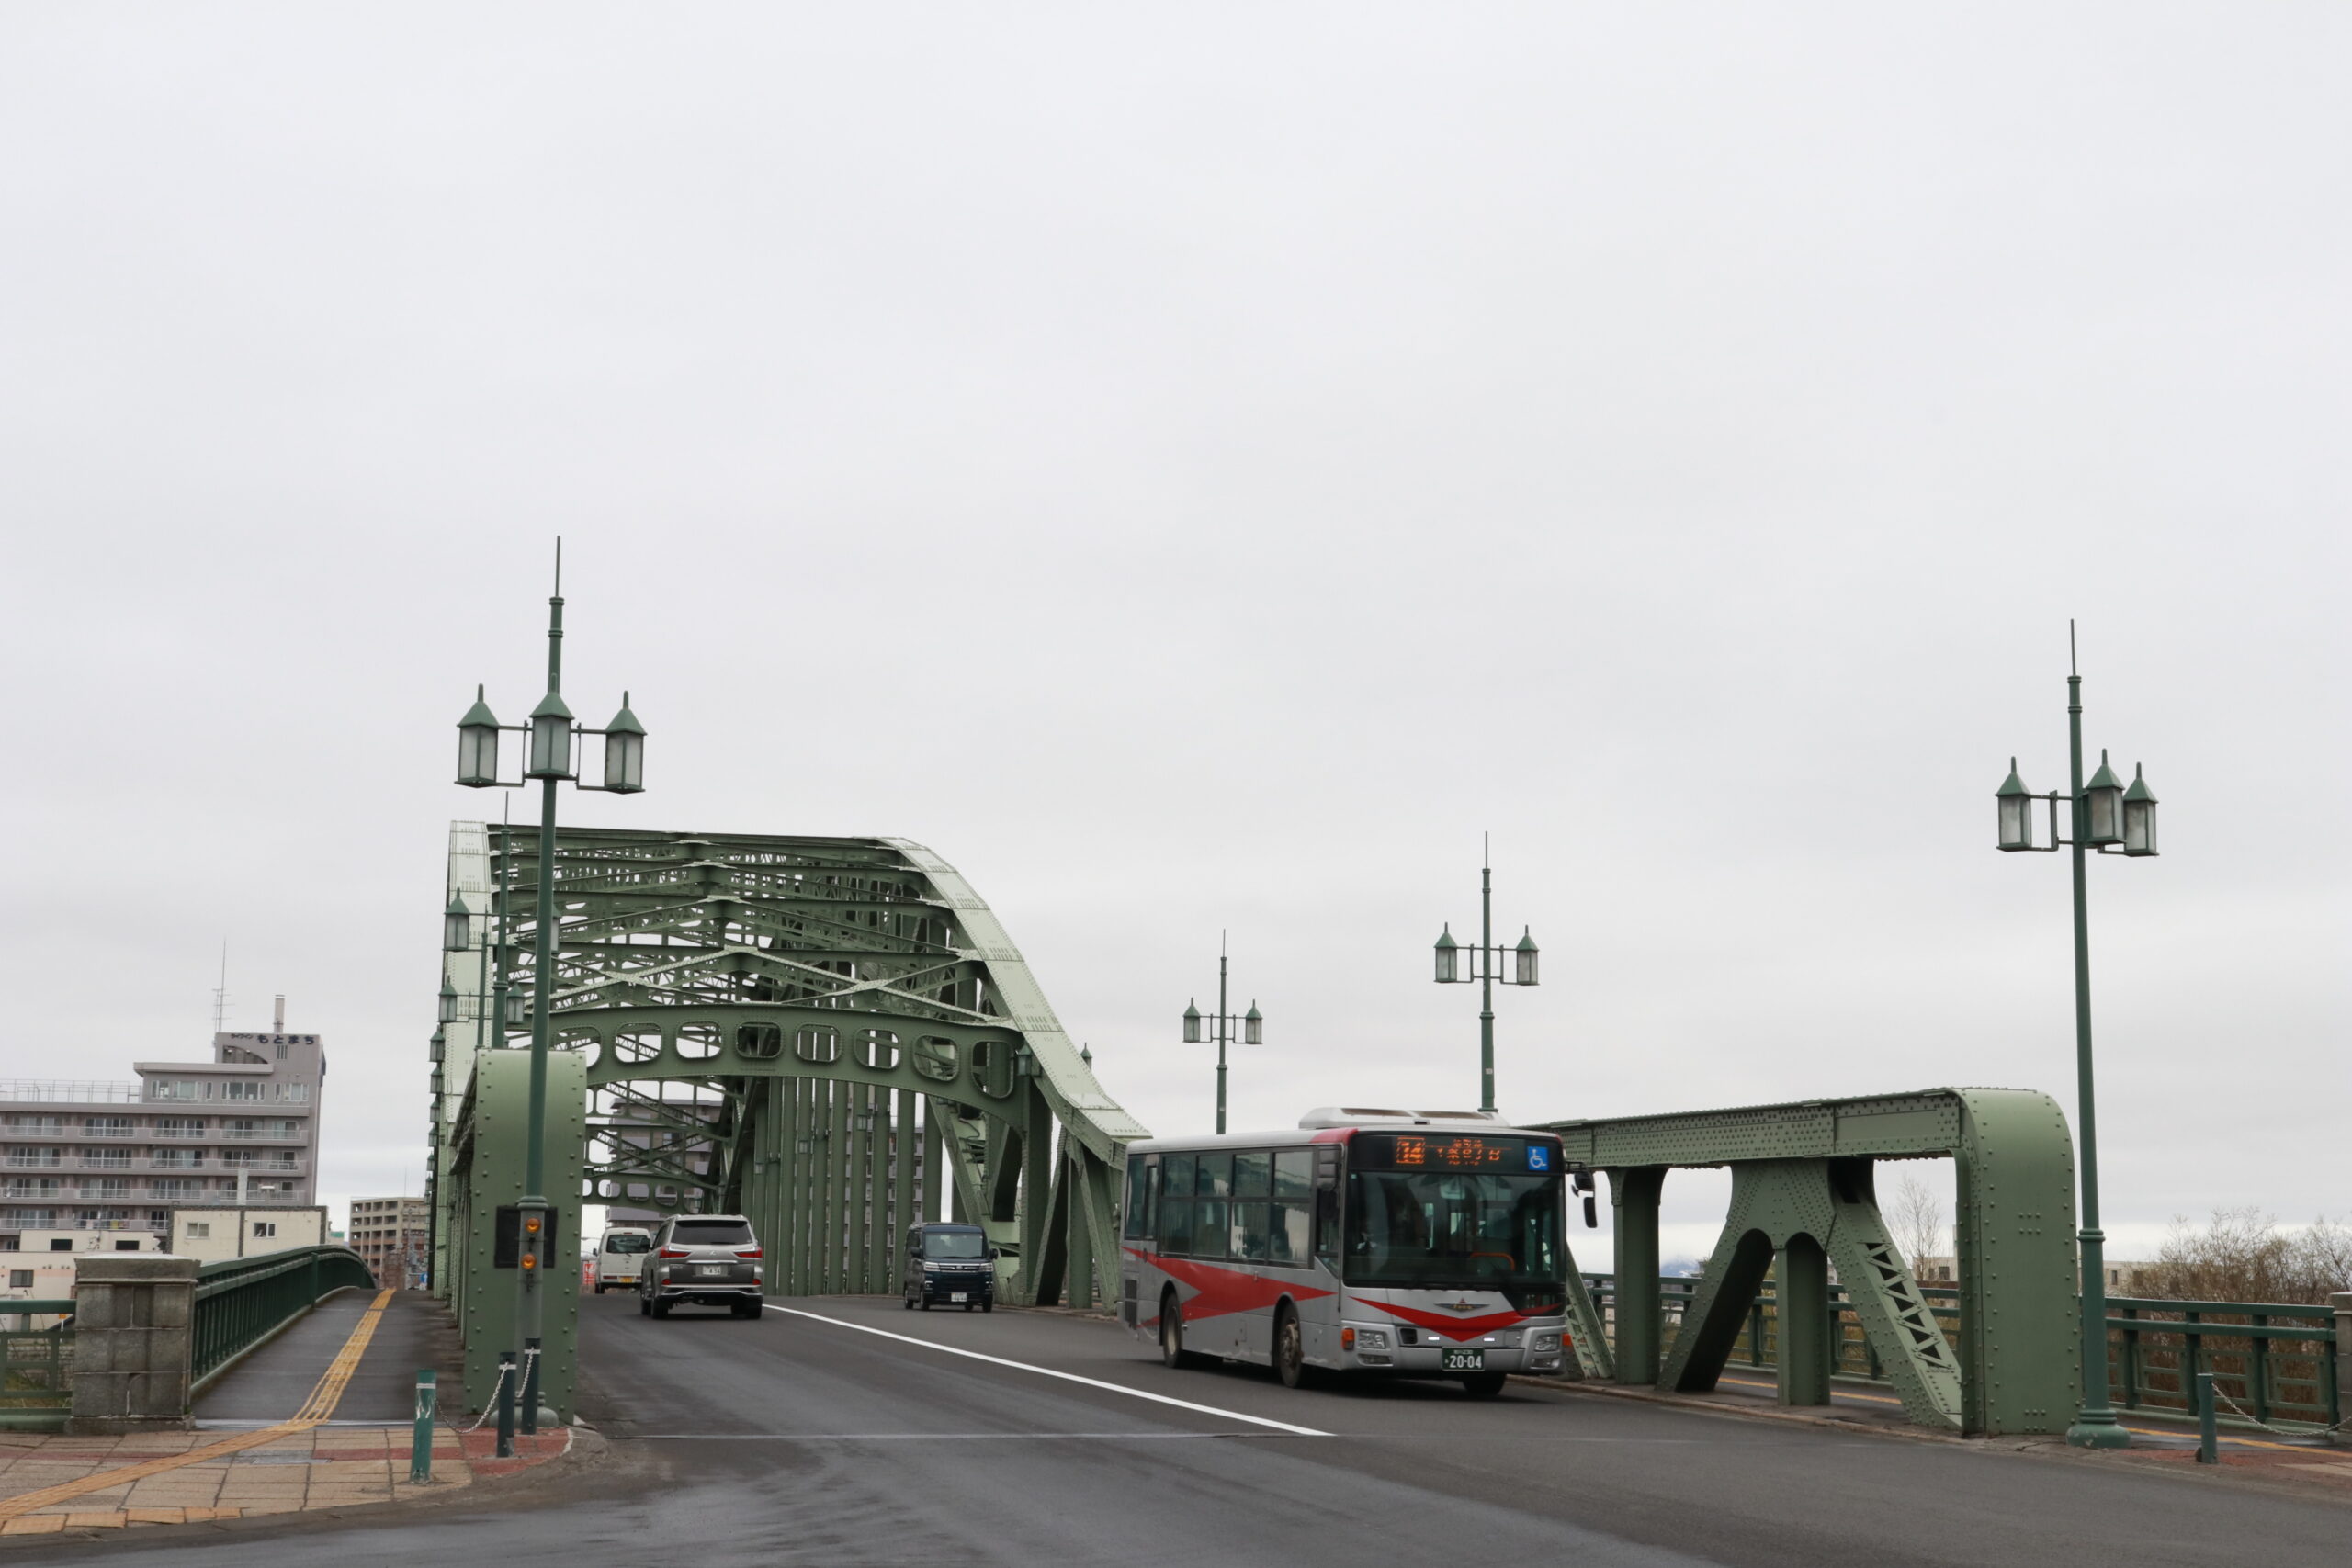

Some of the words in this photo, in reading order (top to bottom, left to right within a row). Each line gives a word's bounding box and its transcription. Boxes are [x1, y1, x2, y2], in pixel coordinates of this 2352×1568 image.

[257, 1034, 314, 1044] もとまち
[1449, 1355, 1482, 1369] 20-04
